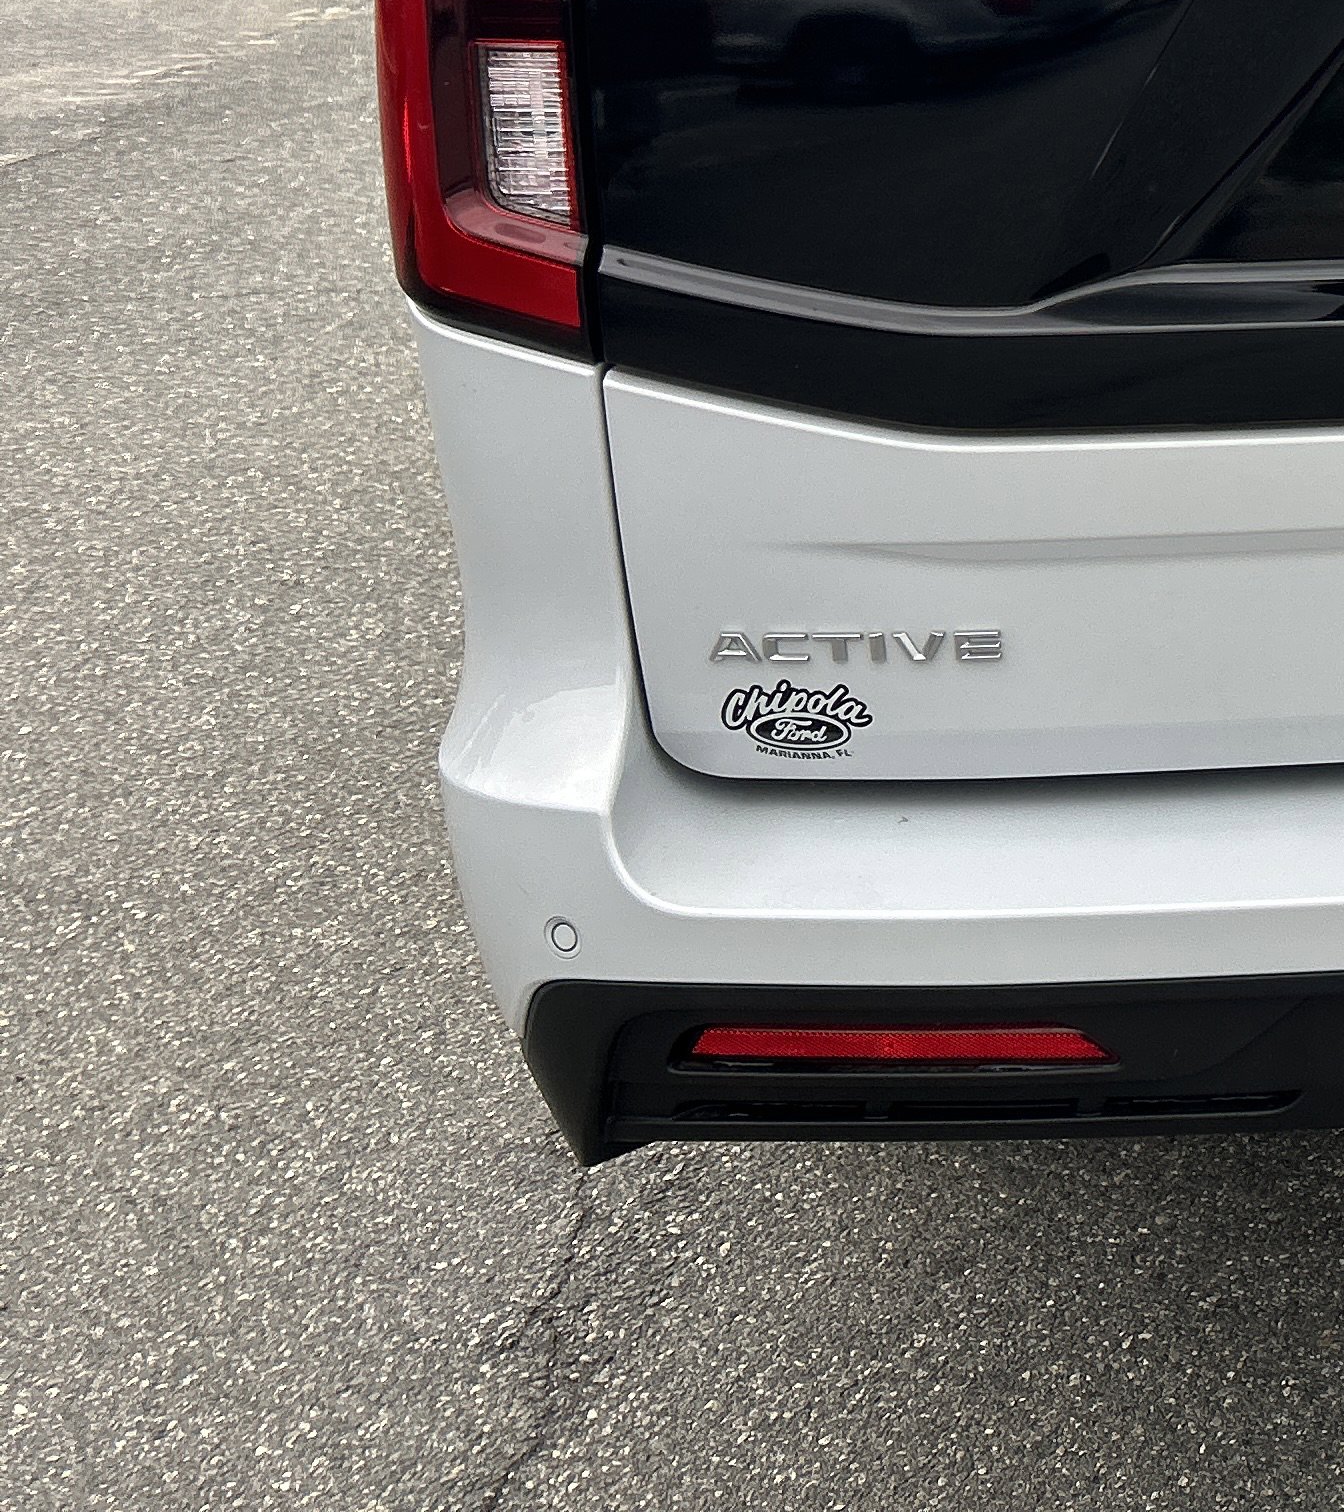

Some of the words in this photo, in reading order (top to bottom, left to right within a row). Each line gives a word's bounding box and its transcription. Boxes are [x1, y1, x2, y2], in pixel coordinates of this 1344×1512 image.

[709, 630, 1002, 663] ACTIVE
[722, 680, 872, 730] Chipola
[770, 718, 828, 743] Ford
[836, 749, 853, 758] FL
